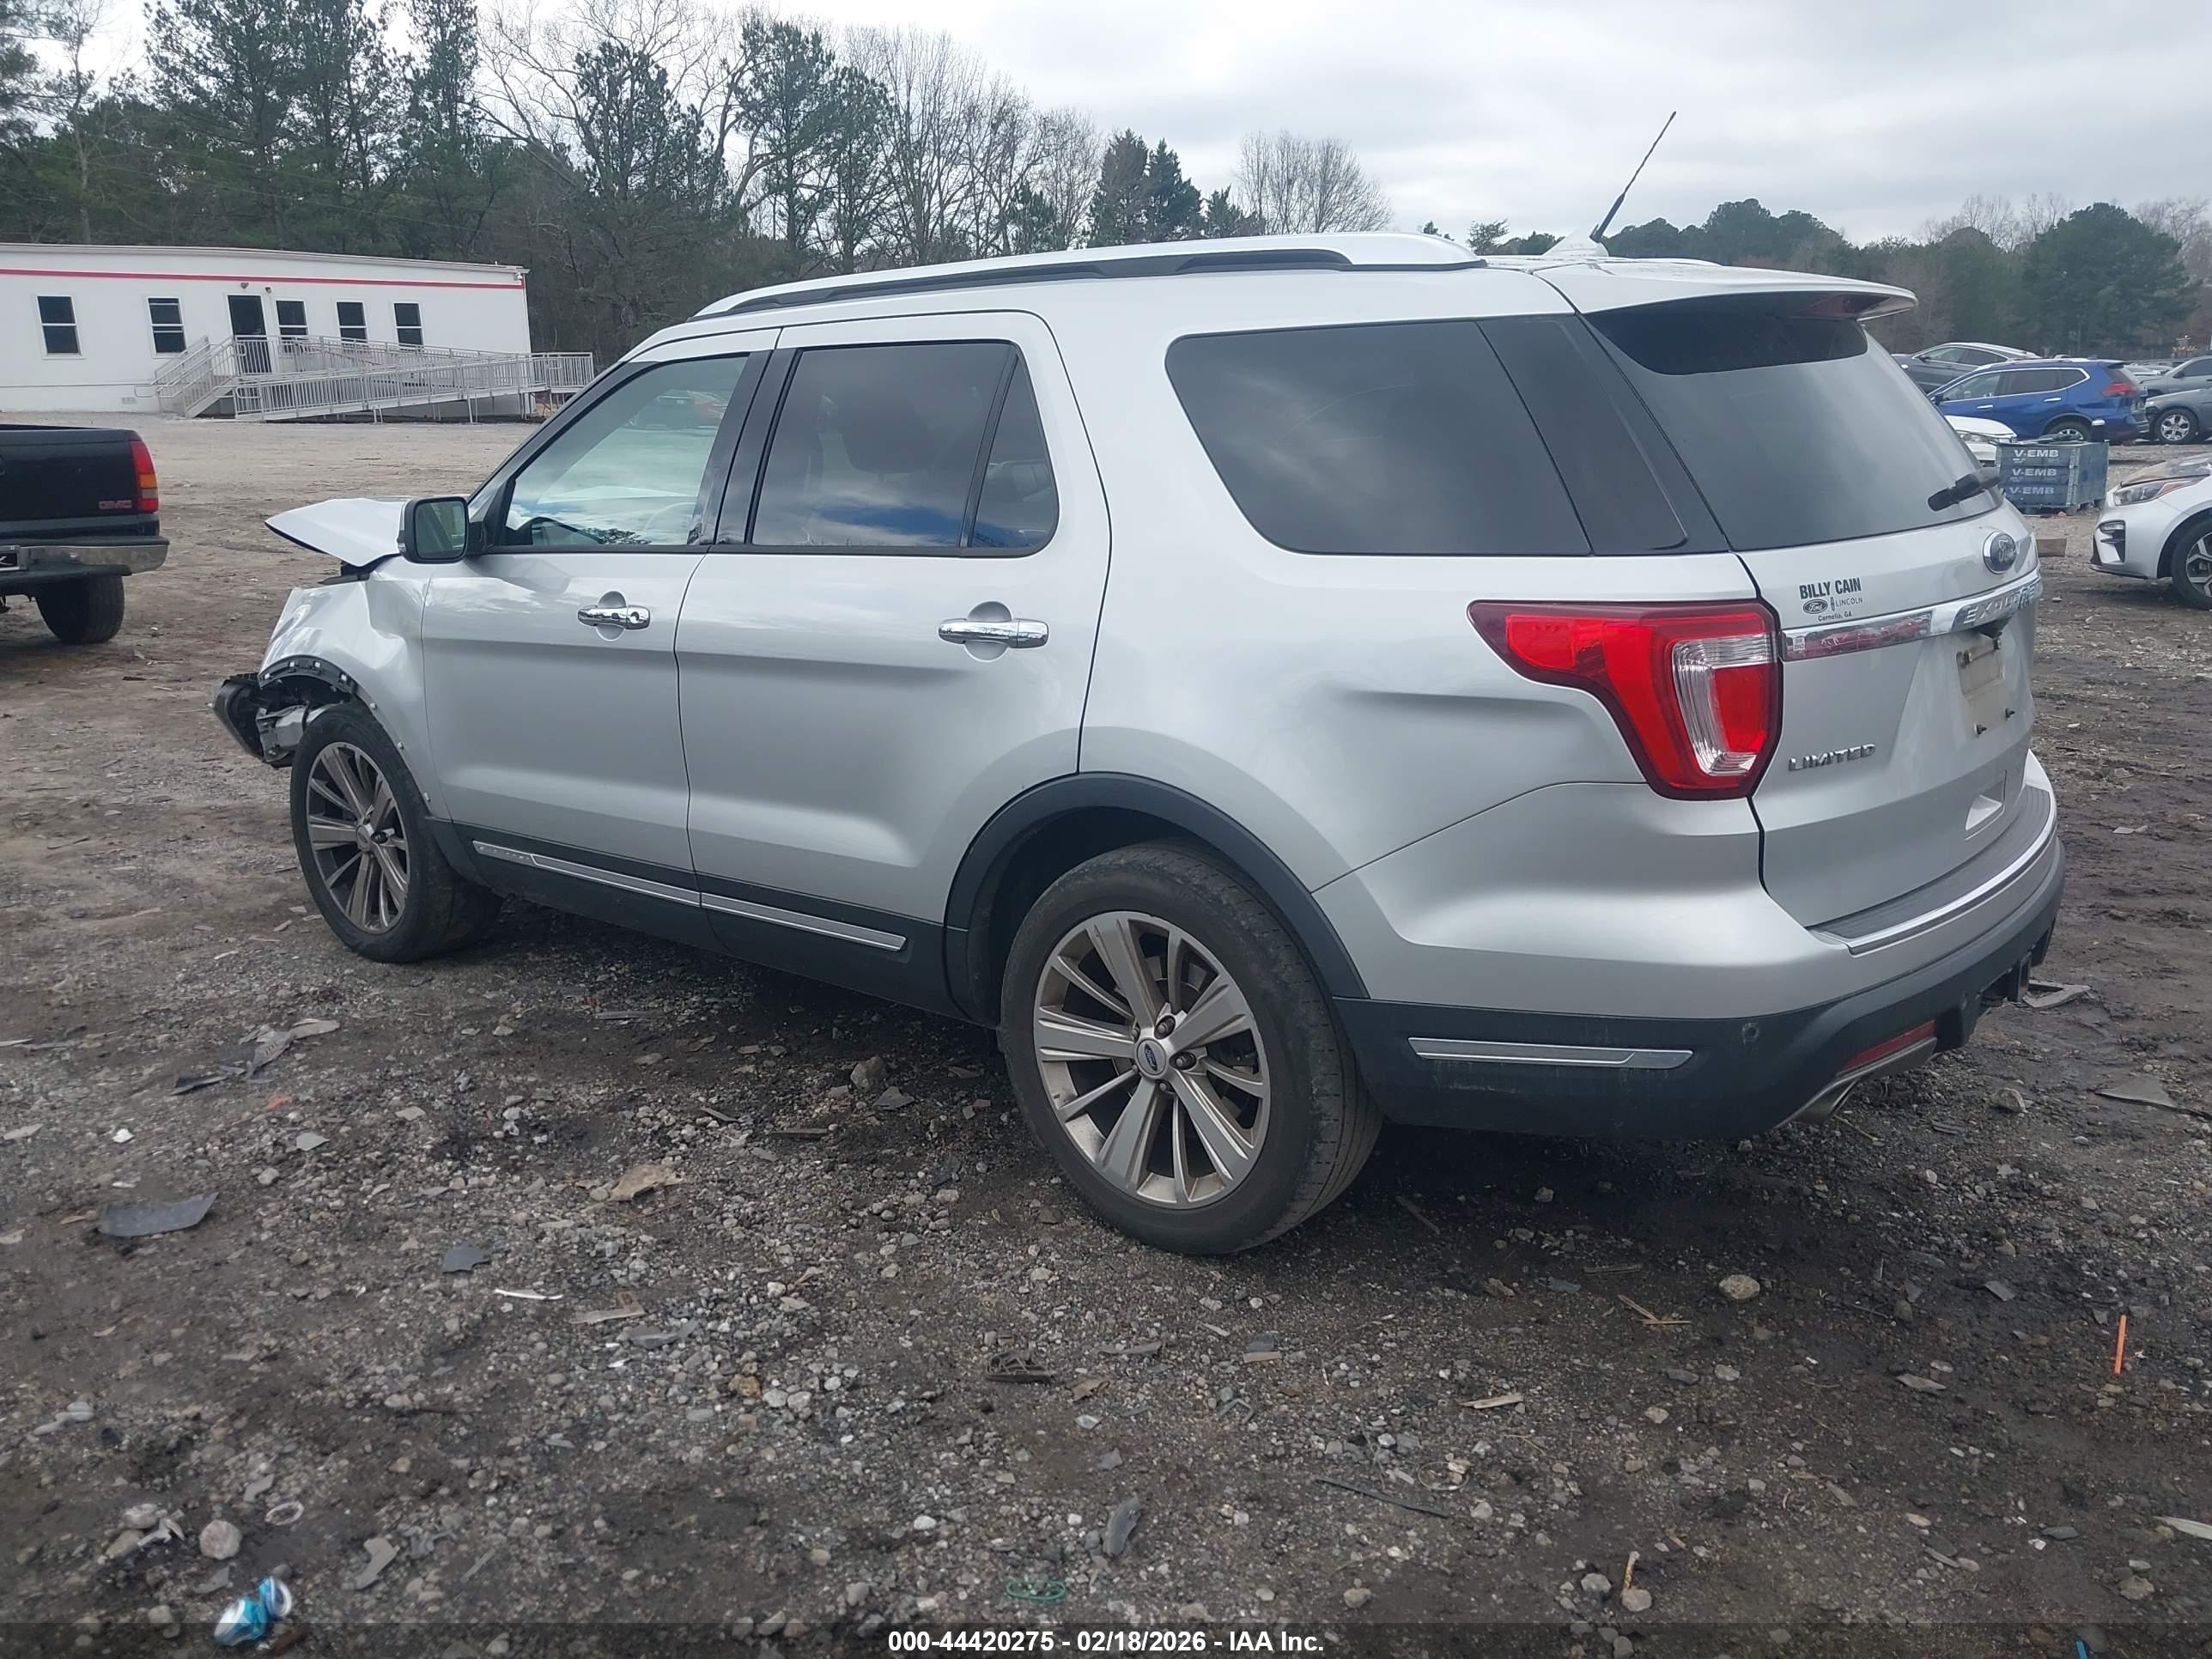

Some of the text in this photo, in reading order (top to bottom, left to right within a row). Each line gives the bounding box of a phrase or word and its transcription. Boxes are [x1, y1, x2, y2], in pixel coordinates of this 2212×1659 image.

[2014, 449, 2059, 458] V-EMB
[2012, 468, 2057, 477] V-EMB
[99, 500, 132, 510] GMC
[1799, 577, 1862, 599] BILLY CAIN
[1835, 597, 1863, 607] LINCOLN
[1788, 744, 1875, 772] LIMITED
